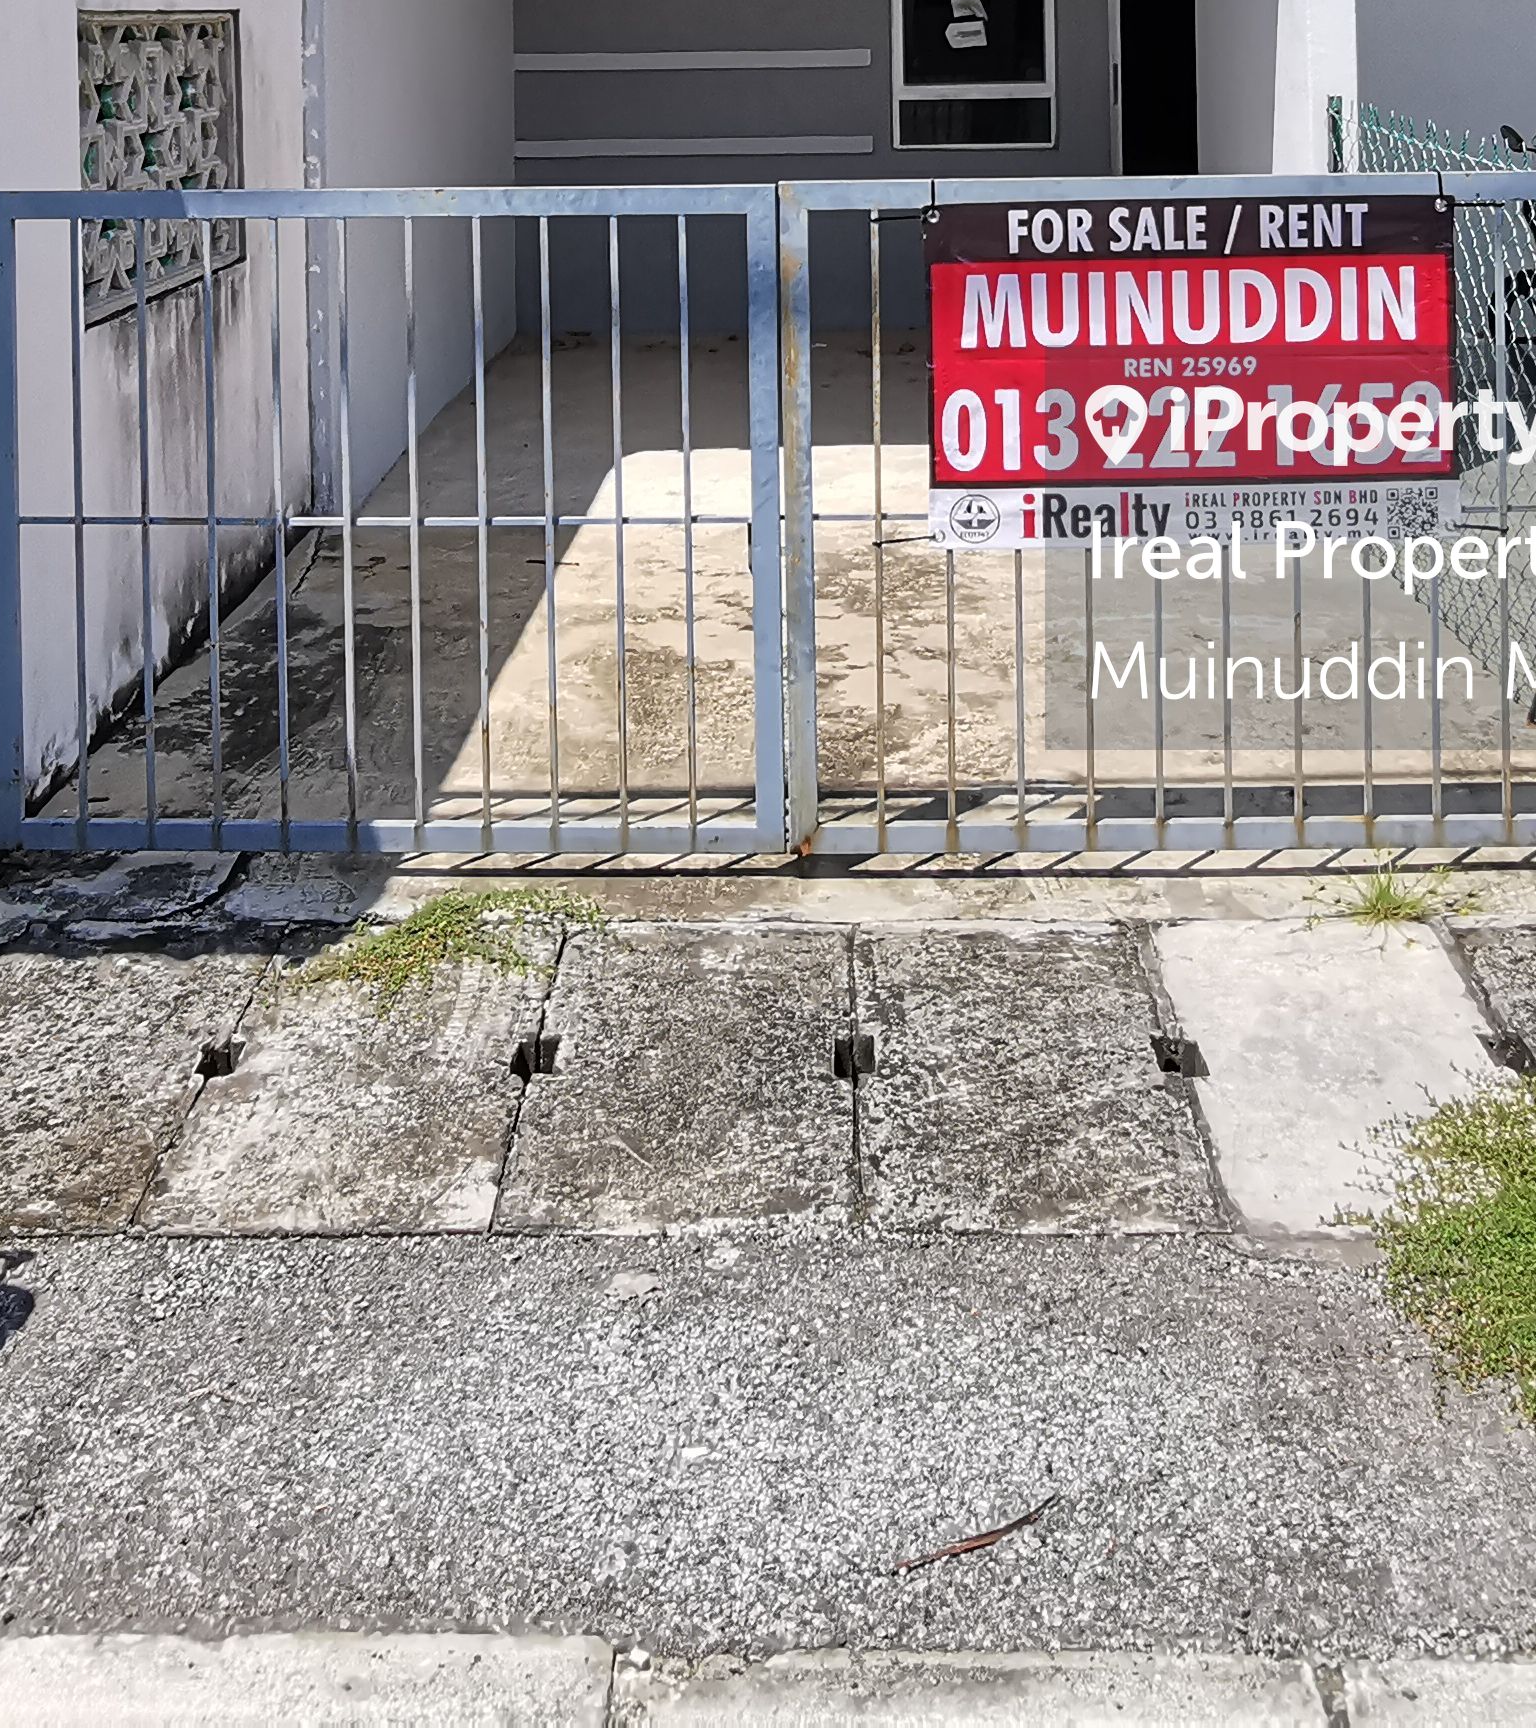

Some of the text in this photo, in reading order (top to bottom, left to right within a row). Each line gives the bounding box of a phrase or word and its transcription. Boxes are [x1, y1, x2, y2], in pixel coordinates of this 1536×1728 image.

[1007, 207, 1093, 254] FOR
[1109, 205, 1207, 251] SALE
[1260, 202, 1369, 249] RENT
[960, 265, 1417, 349] MUINUDDIN
[1124, 355, 1258, 378] REN 25969
[941, 386, 1079, 472] 013
[1019, 491, 1171, 540] iRealty
[1185, 508, 1379, 530] 03 8861 2694
[1233, 490, 1307, 507] PROPERTY
[1314, 489, 1342, 505] SDN
[1348, 489, 1378, 504] BHD
